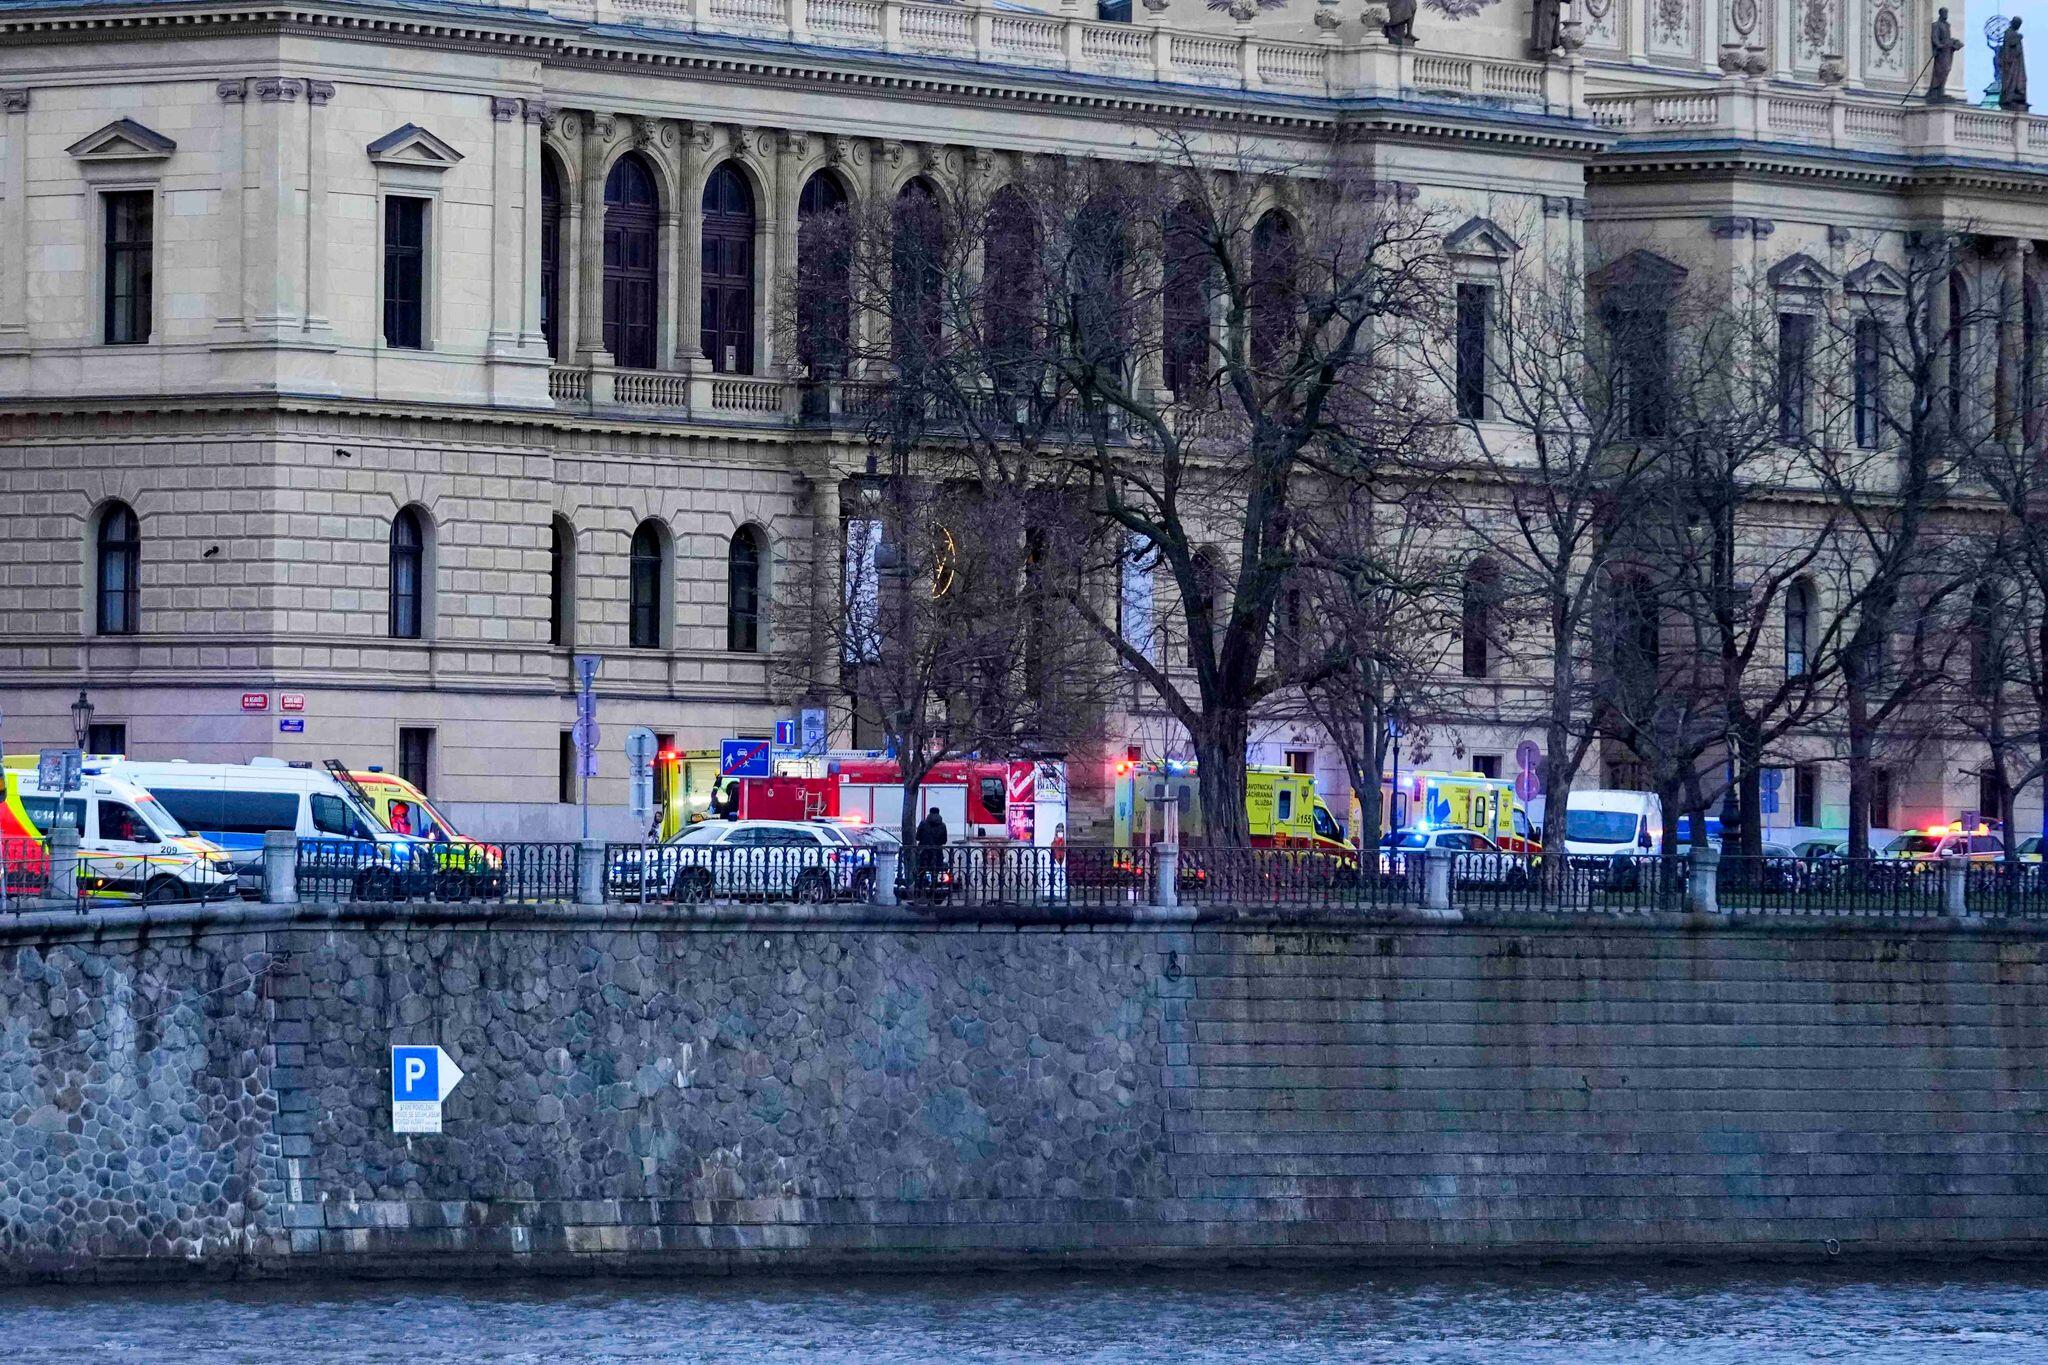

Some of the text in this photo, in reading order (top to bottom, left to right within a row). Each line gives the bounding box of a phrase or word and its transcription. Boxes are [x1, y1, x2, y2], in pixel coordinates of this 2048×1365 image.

[1301, 815, 1312, 824] 155
[160, 845, 178, 855] 209
[405, 1057, 427, 1093] P
